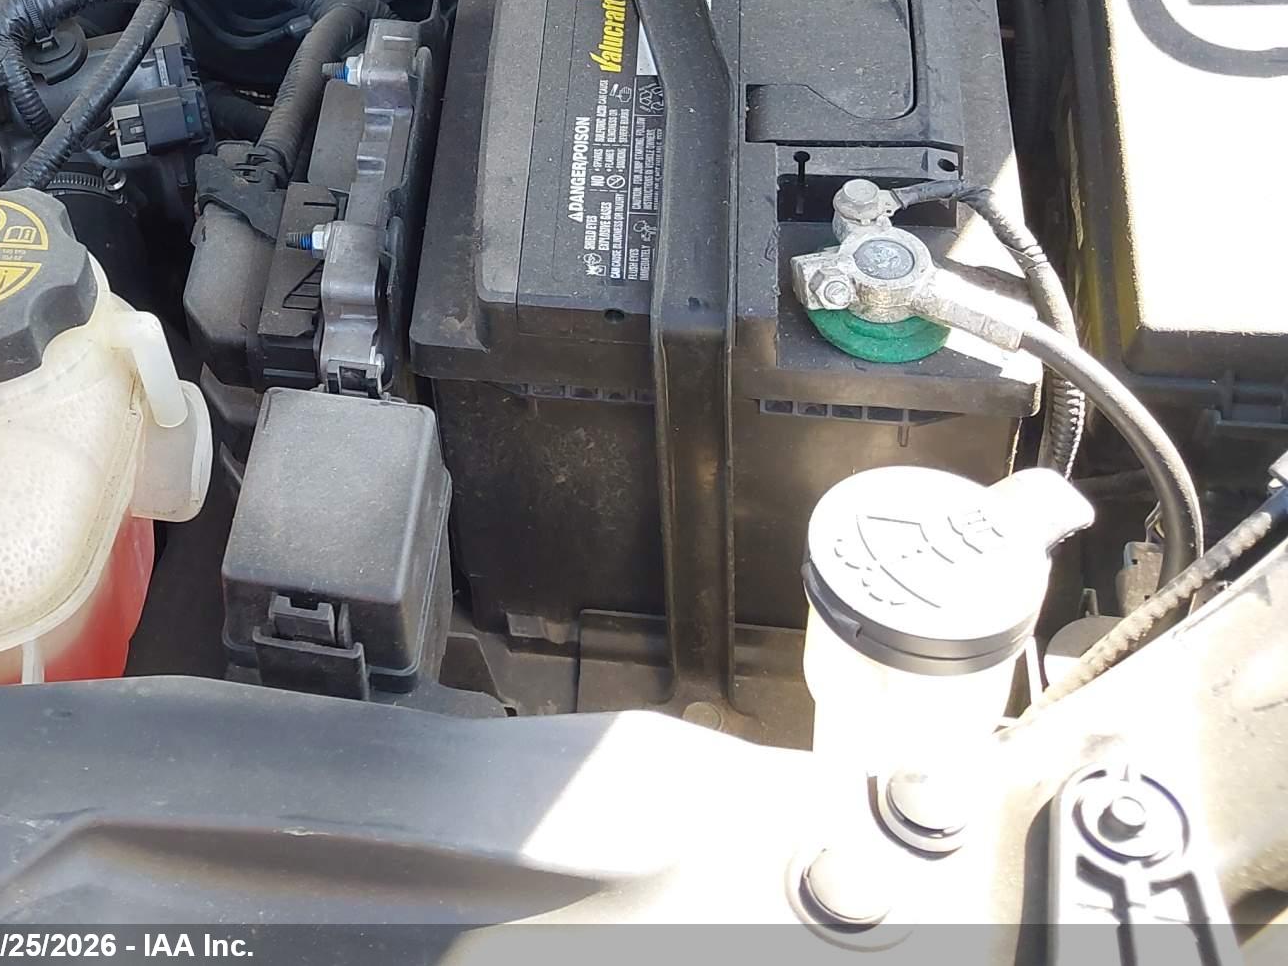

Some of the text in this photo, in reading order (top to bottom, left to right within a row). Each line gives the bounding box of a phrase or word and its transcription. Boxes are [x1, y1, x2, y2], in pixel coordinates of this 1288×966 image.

[595, 118, 606, 142] SULFURIC
[569, 117, 590, 212] DANGER/POISON
[605, 149, 614, 168] FLAMES
[591, 175, 605, 186] NO
[584, 215, 597, 250] SHIELD EYES
[599, 202, 612, 250] EXPLOSIVE GASES
[613, 221, 623, 249] BLINDNESS
[612, 250, 622, 266] CAUSE
[628, 248, 639, 280] FLUSH EYES
[610, 267, 620, 279] CAN
